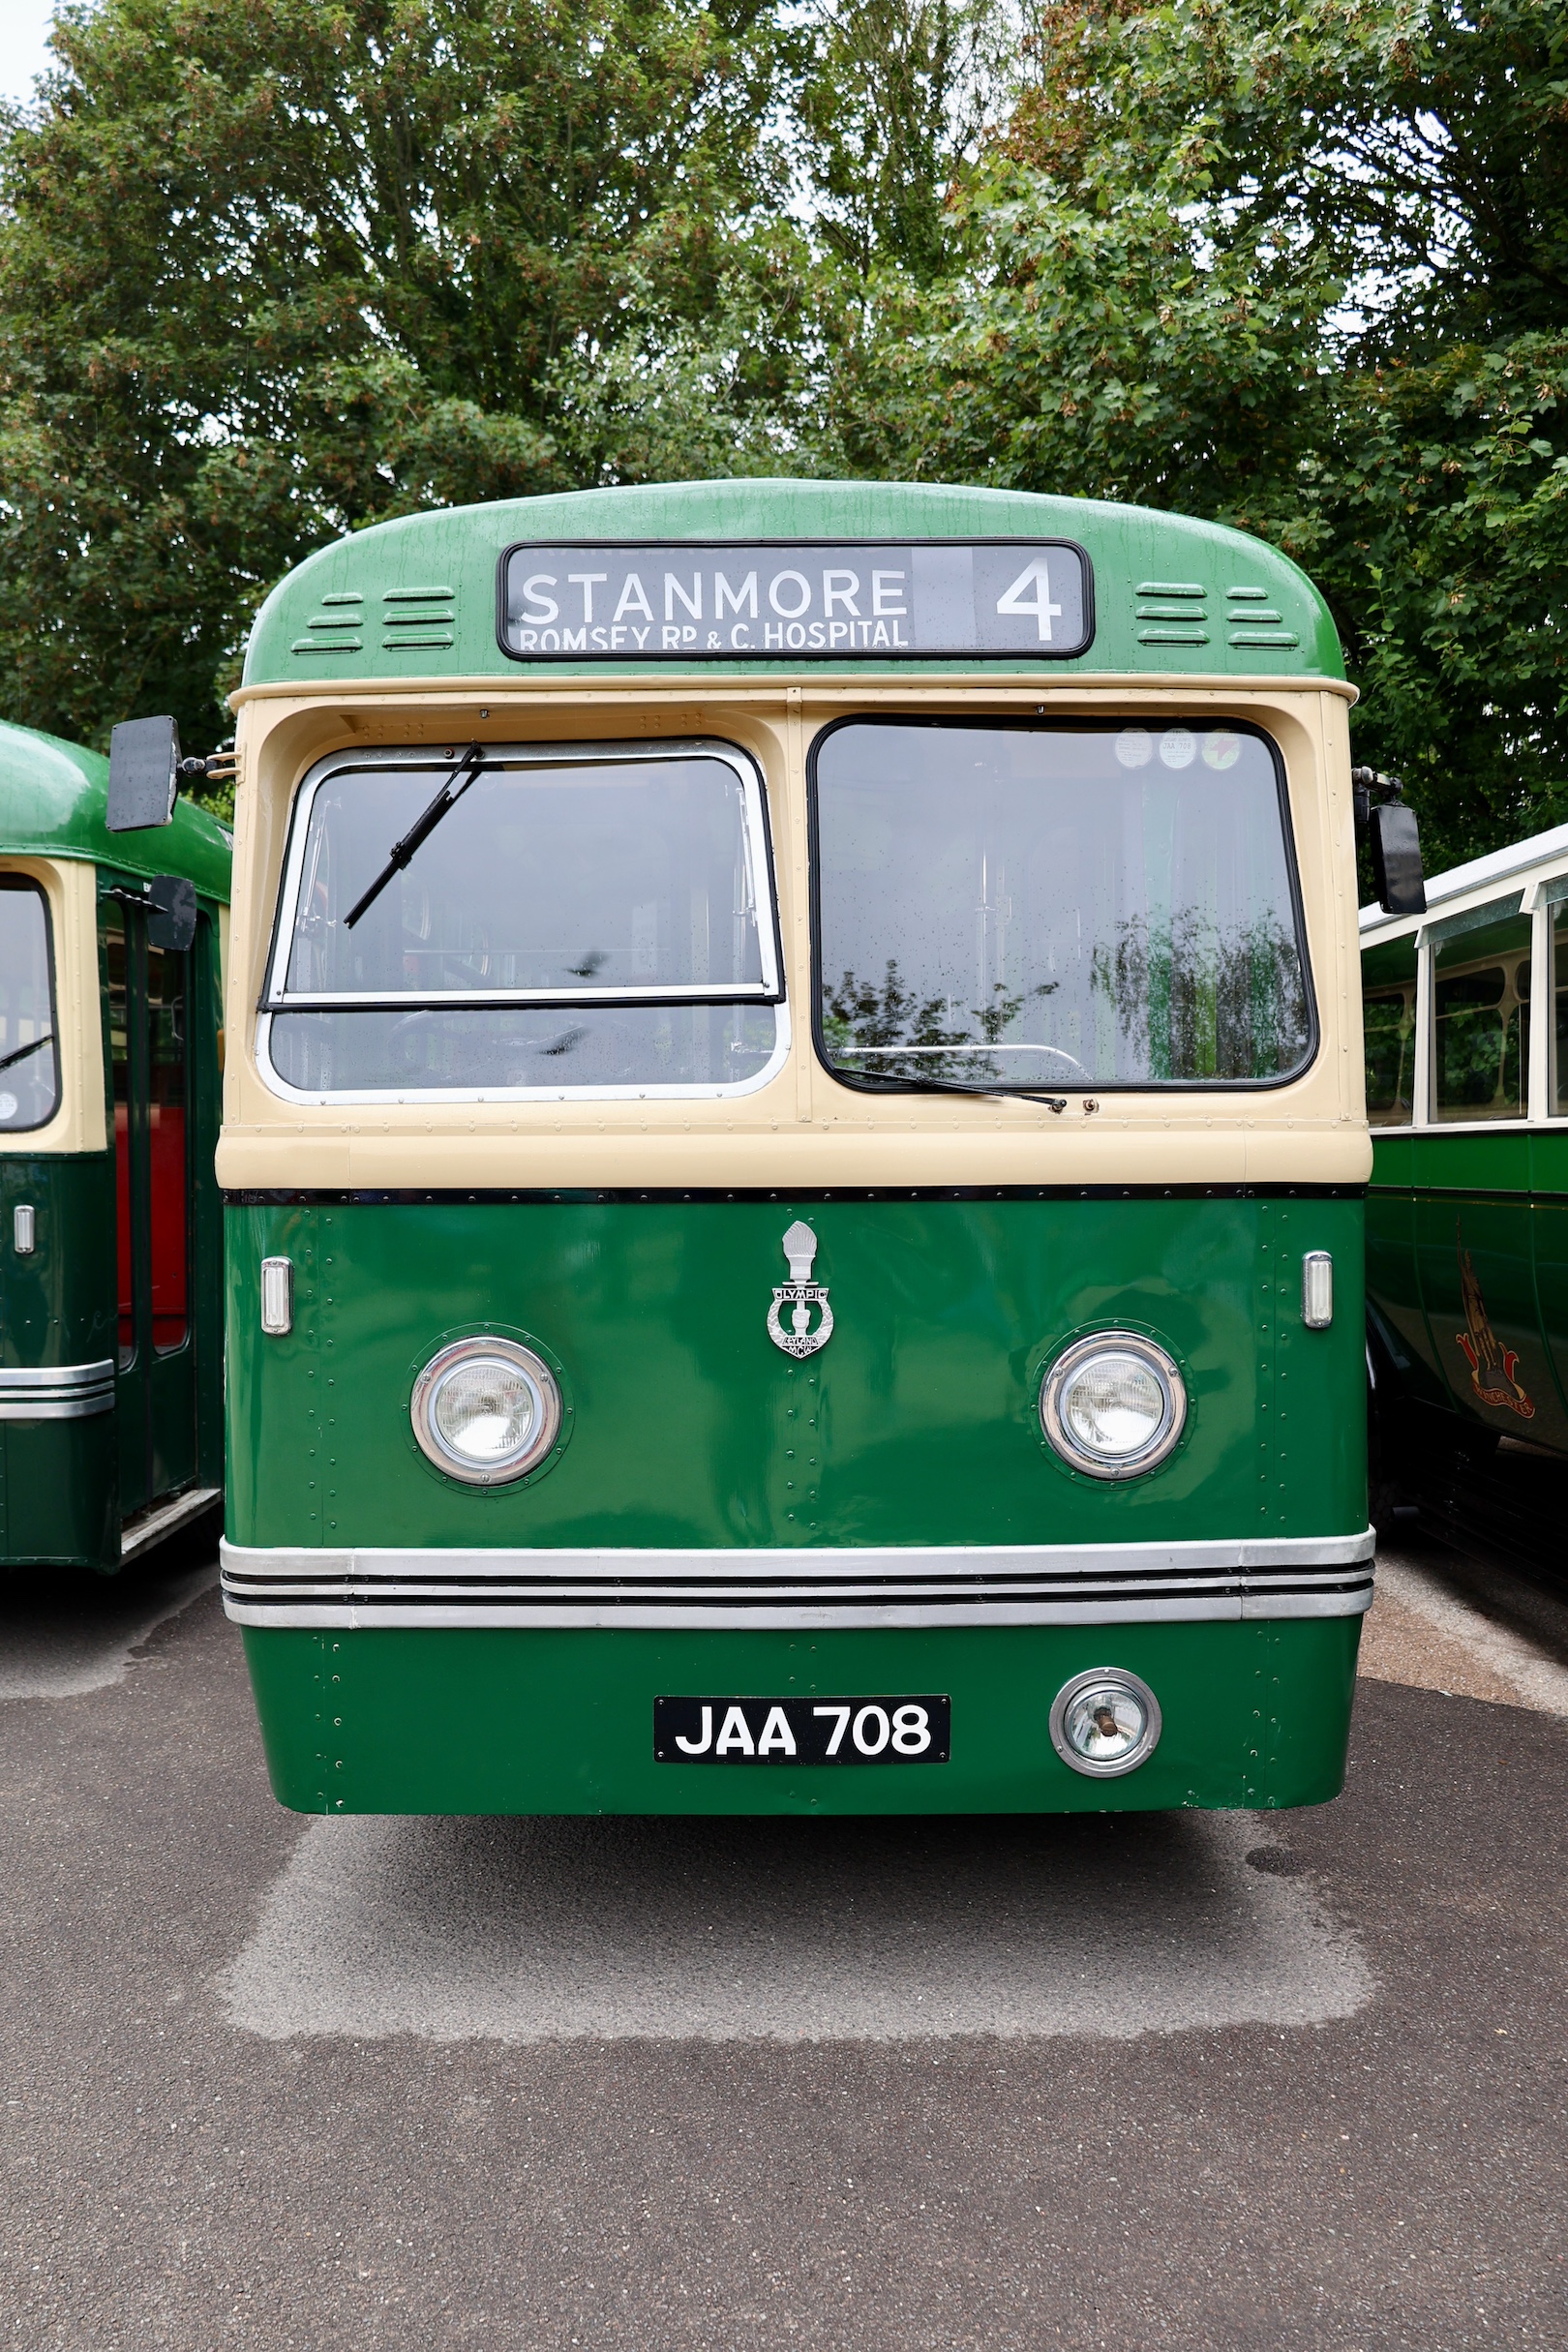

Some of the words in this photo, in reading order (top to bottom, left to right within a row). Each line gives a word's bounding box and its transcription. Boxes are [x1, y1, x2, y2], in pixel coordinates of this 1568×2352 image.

[520, 569, 906, 625] STANMORE
[996, 557, 1063, 642] 4
[519, 625, 652, 650] ROMSEY
[707, 631, 722, 649] &
[764, 619, 909, 649] HOSPITAL
[775, 1289, 828, 1299] OLYMPIC
[782, 1337, 819, 1345] LEYLAND
[1474, 1384, 1533, 1415] WINCHESTER
[675, 1705, 798, 1756] JAA
[812, 1704, 932, 1756] 708
